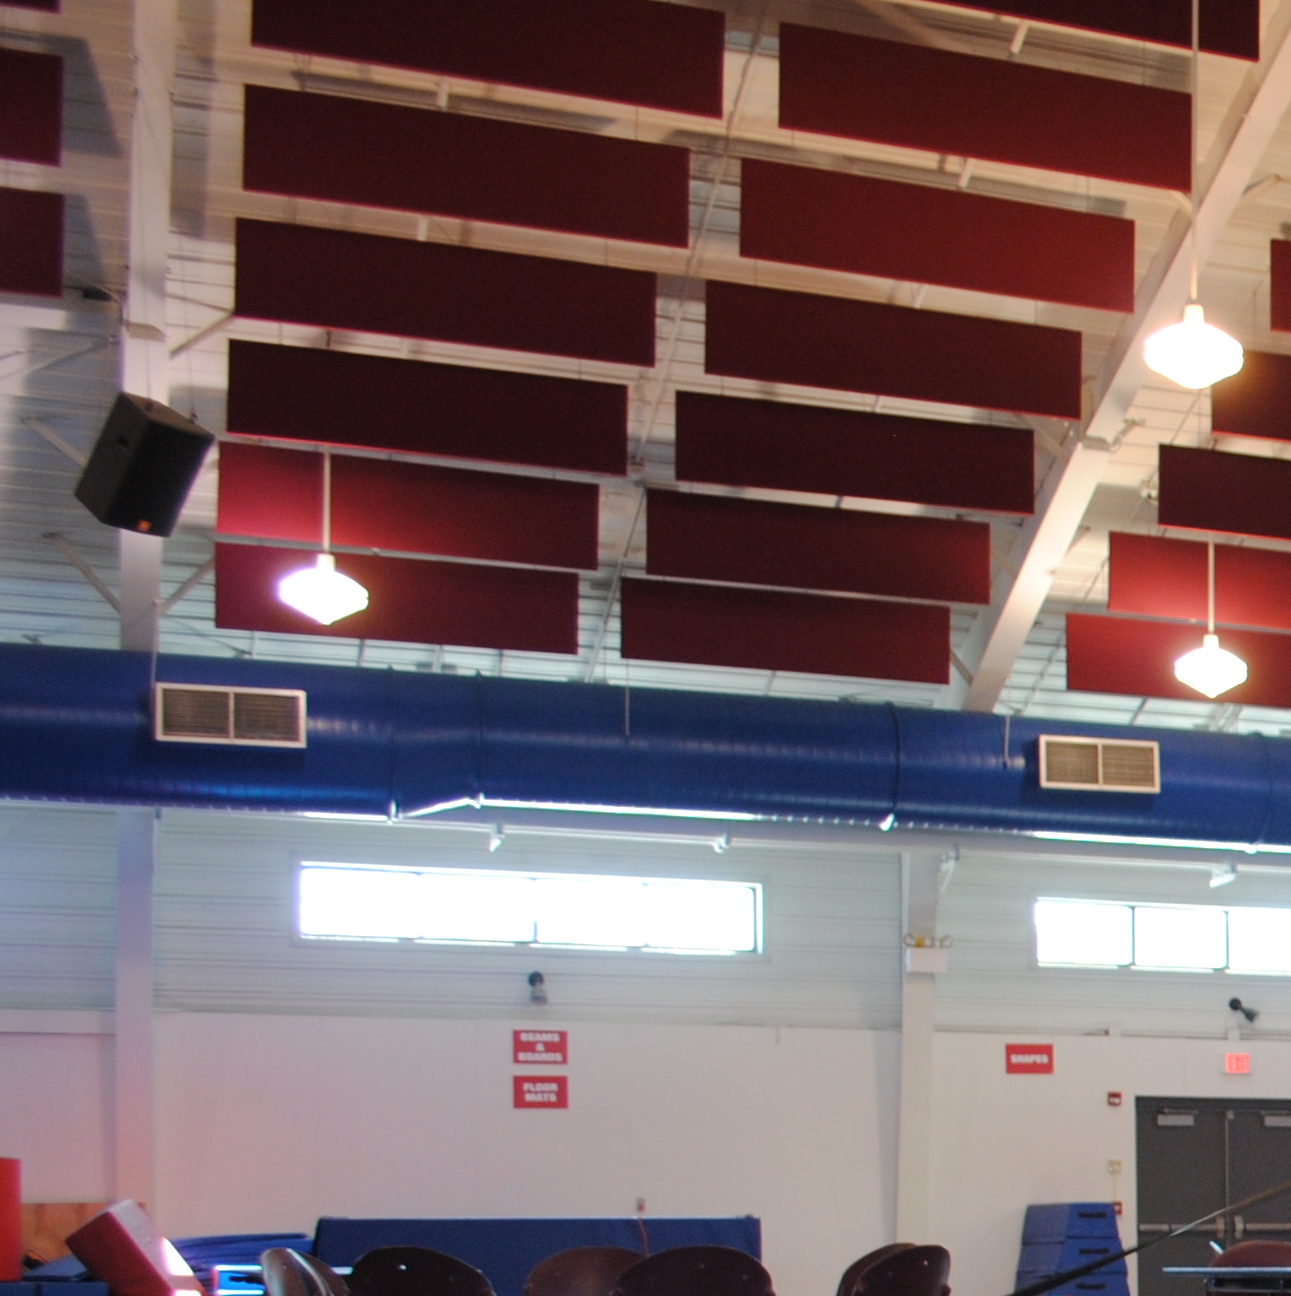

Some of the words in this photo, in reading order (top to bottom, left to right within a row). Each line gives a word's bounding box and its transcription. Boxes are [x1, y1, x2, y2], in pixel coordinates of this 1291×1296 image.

[1010, 1054, 1048, 1064] SHAPES
[523, 1082, 558, 1092] FLOOR
[525, 1093, 557, 1103] MATS
